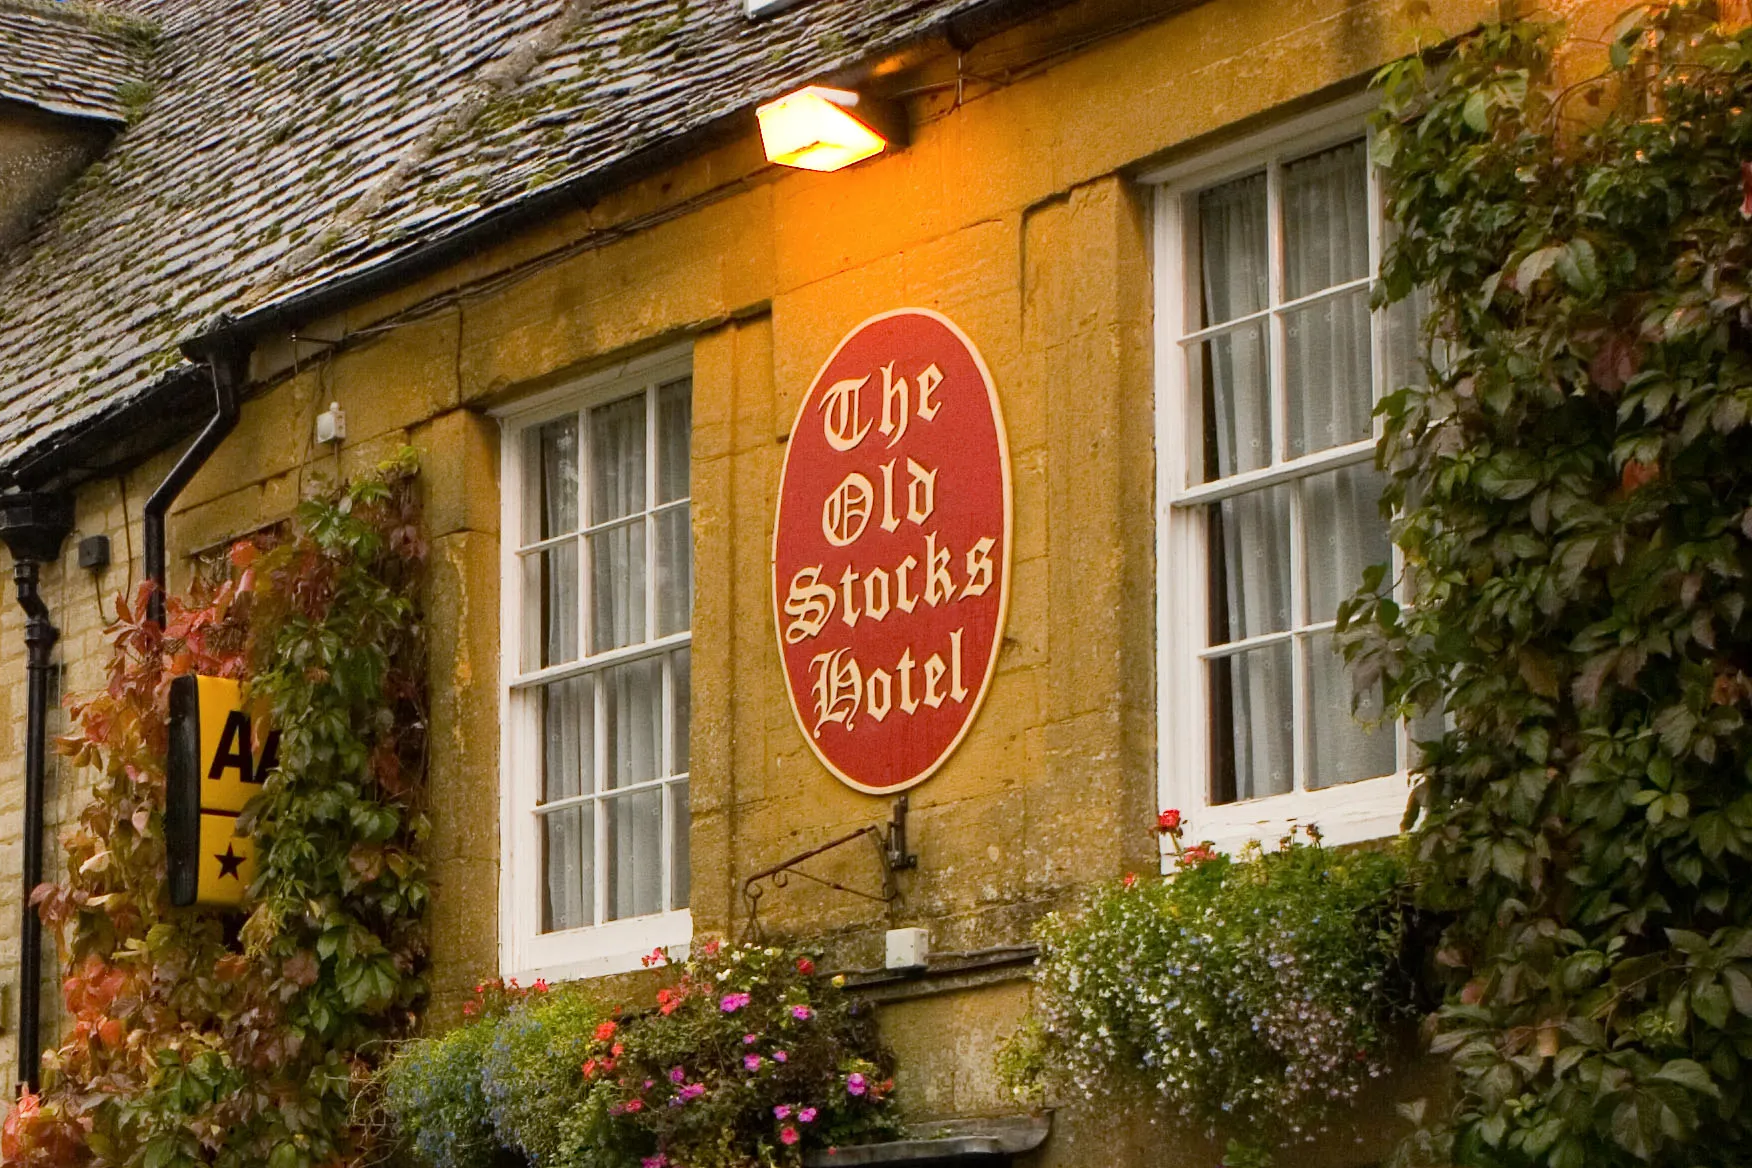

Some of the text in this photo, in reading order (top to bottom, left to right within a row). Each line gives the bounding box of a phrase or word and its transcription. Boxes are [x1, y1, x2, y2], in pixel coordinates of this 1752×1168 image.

[818, 359, 945, 452] The
[821, 457, 938, 548] Old
[783, 530, 997, 645] Stocks
[808, 627, 970, 739] Hotel
